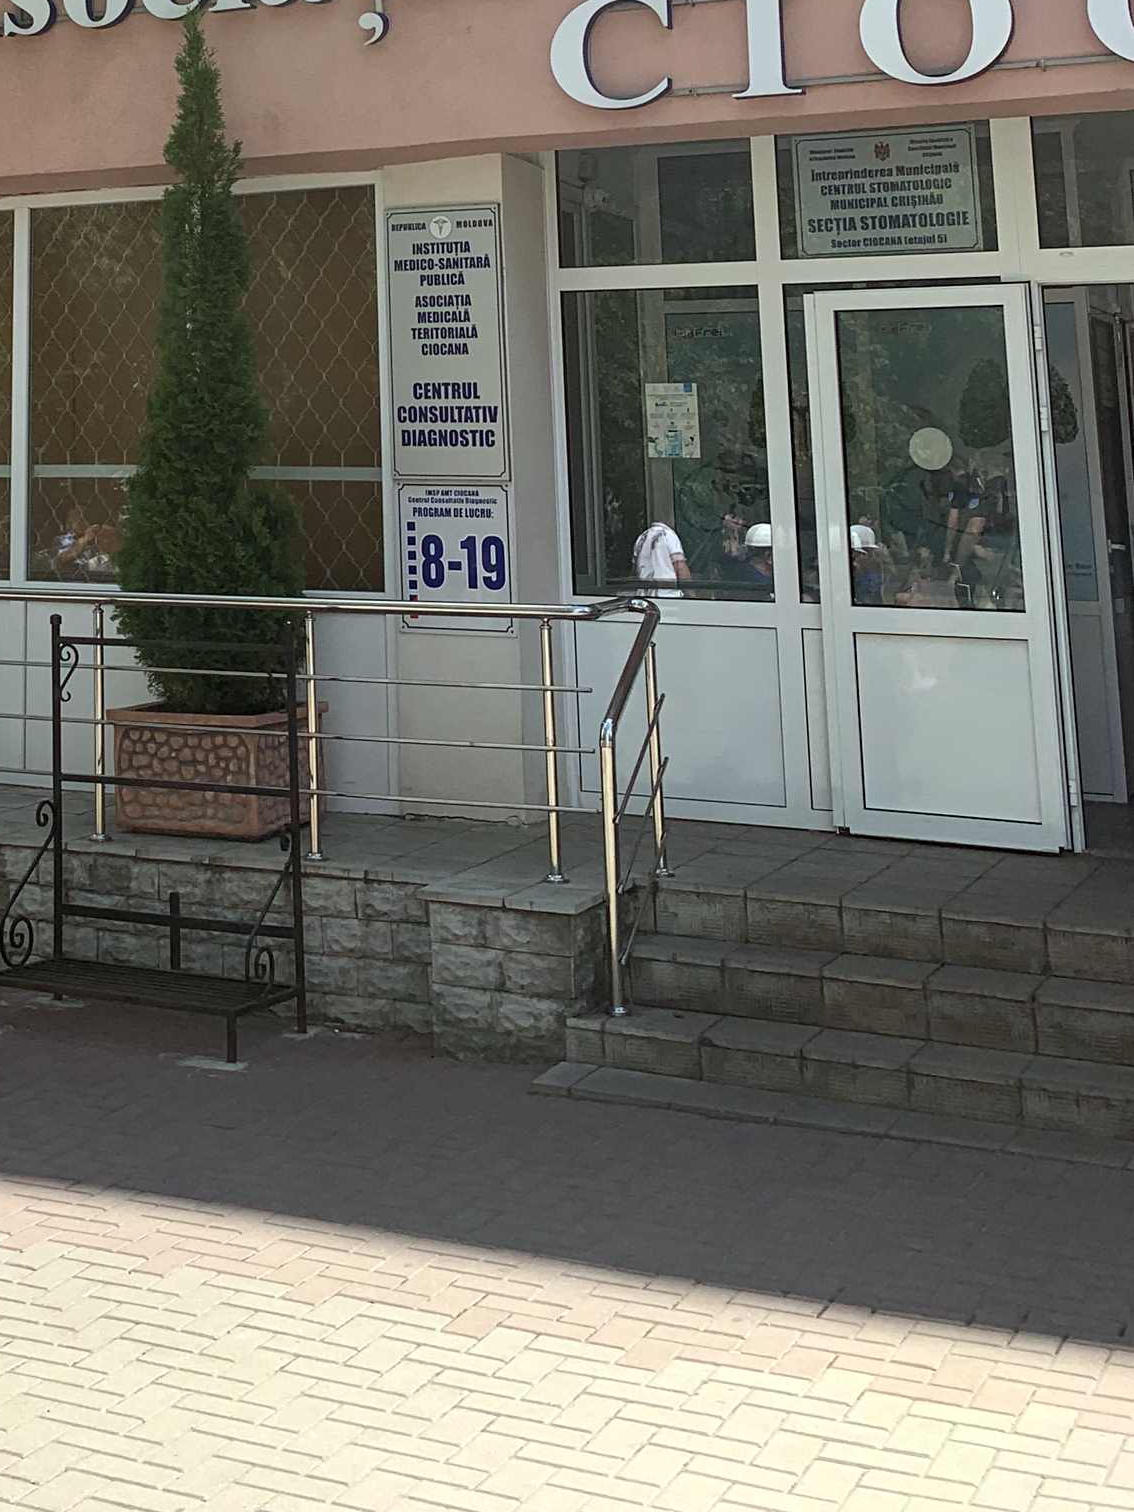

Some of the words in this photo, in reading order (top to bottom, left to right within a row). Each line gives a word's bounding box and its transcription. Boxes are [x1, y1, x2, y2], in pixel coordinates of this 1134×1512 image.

[820, 184, 866, 196] CENTRUL
[869, 178, 952, 194] STOMATOLOGIC
[830, 197, 889, 210] MUNICIPAL
[391, 222, 426, 232] REPUBLICA
[456, 219, 493, 228] MOLDOVA
[808, 216, 857, 235] SECȚIA
[860, 211, 969, 231] STOMATOLOGIE
[412, 241, 470, 256] INSTITUȚIA
[830, 238, 861, 249] Sector
[394, 254, 490, 272] MEDICO-SANITARĂ
[420, 271, 465, 286] PUBLICĂ
[415, 294, 471, 310] ASOCIAȚIA
[417, 308, 470, 324] MEDICALĂ
[411, 324, 478, 340] TERITORIALĂ
[421, 343, 469, 356] CIOCANA
[412, 382, 480, 400] CENTRUL
[397, 405, 498, 424] CONSULTATIV
[401, 429, 496, 448] DIAGNOSTIC
[412, 507, 451, 517] PROGRAM
[453, 507, 463, 517] DE
[421, 534, 506, 590] 8-19
